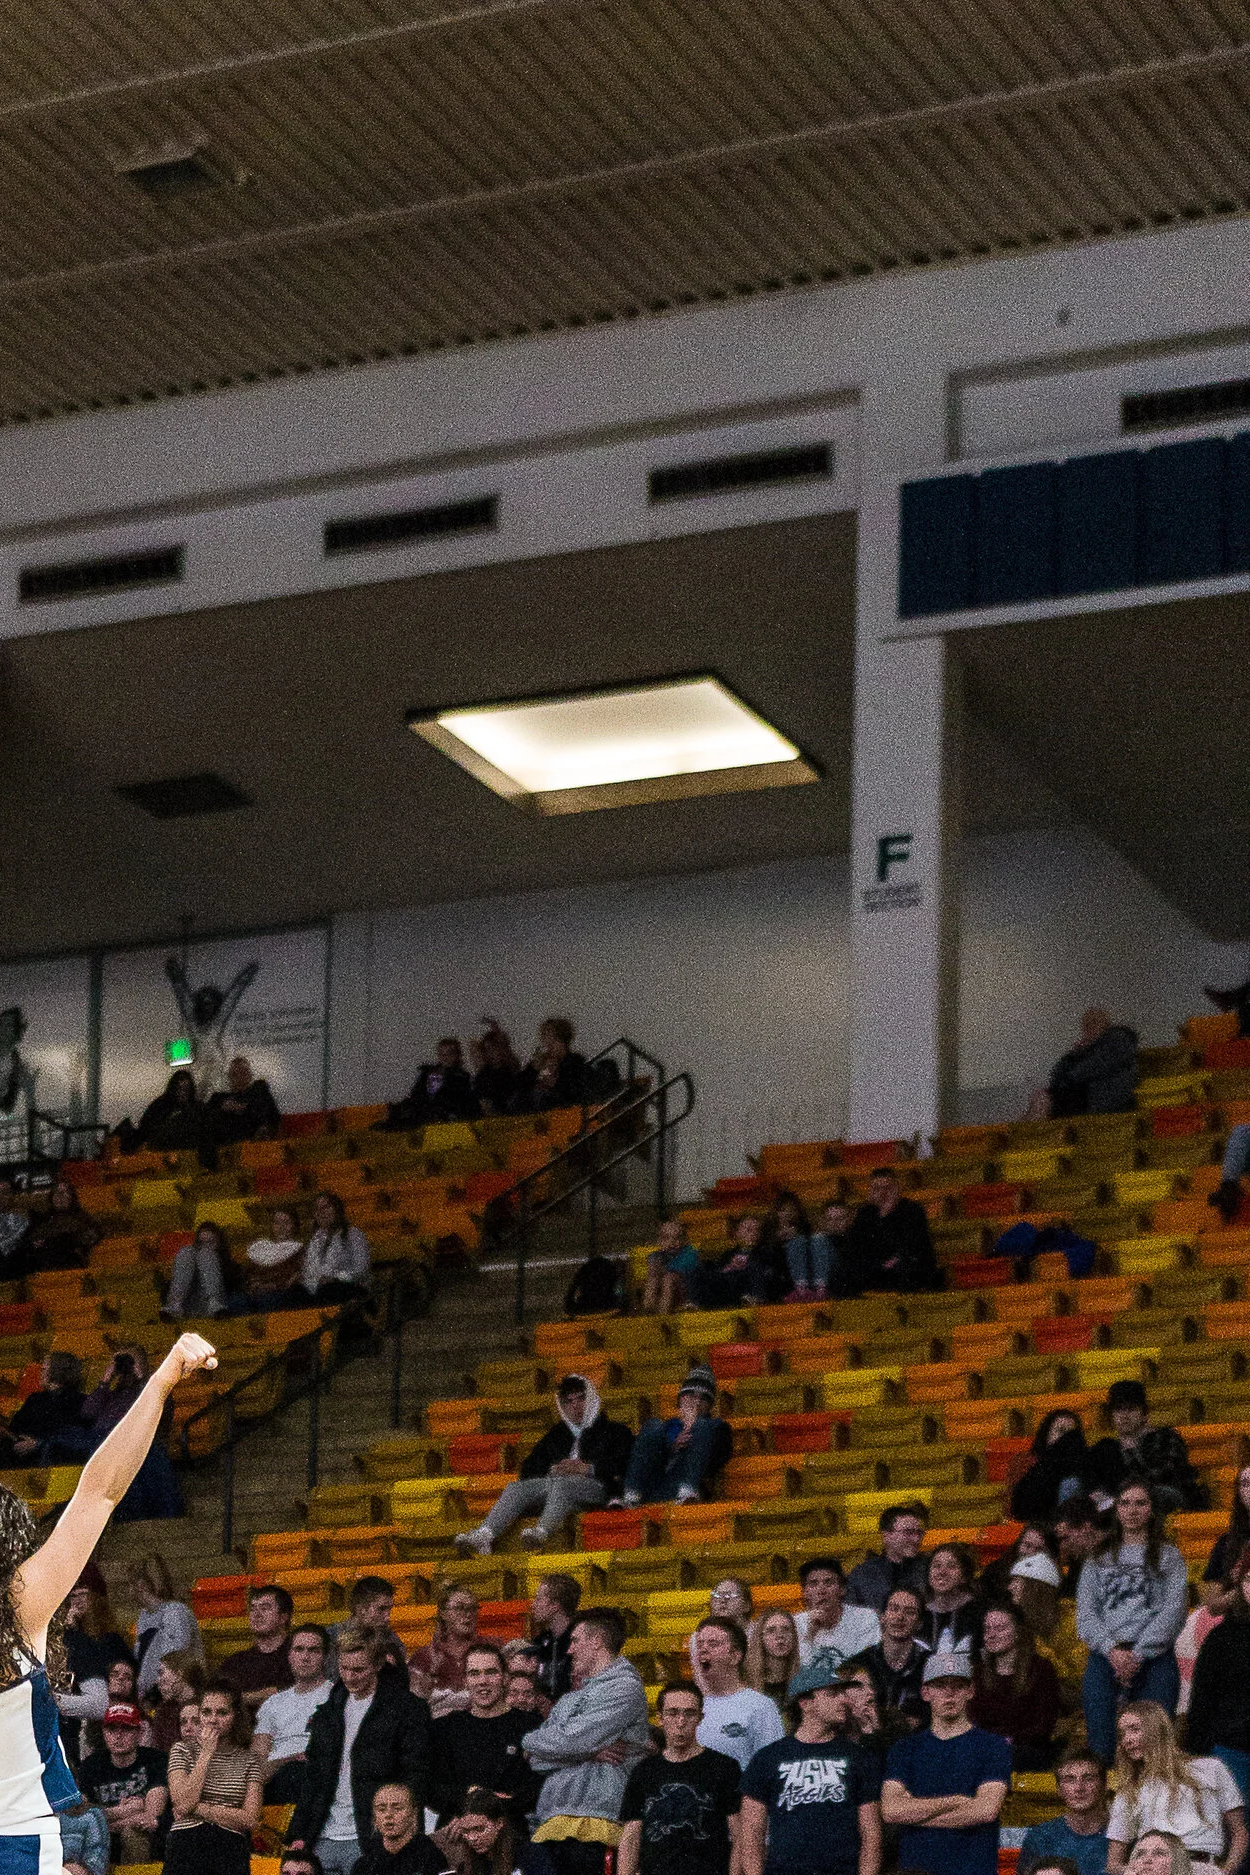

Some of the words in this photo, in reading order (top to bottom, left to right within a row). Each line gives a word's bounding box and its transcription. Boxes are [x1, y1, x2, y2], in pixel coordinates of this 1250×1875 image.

[877, 834, 914, 883] F
[778, 1759, 847, 1790] USU
[776, 1784, 846, 1812] AGGIES
